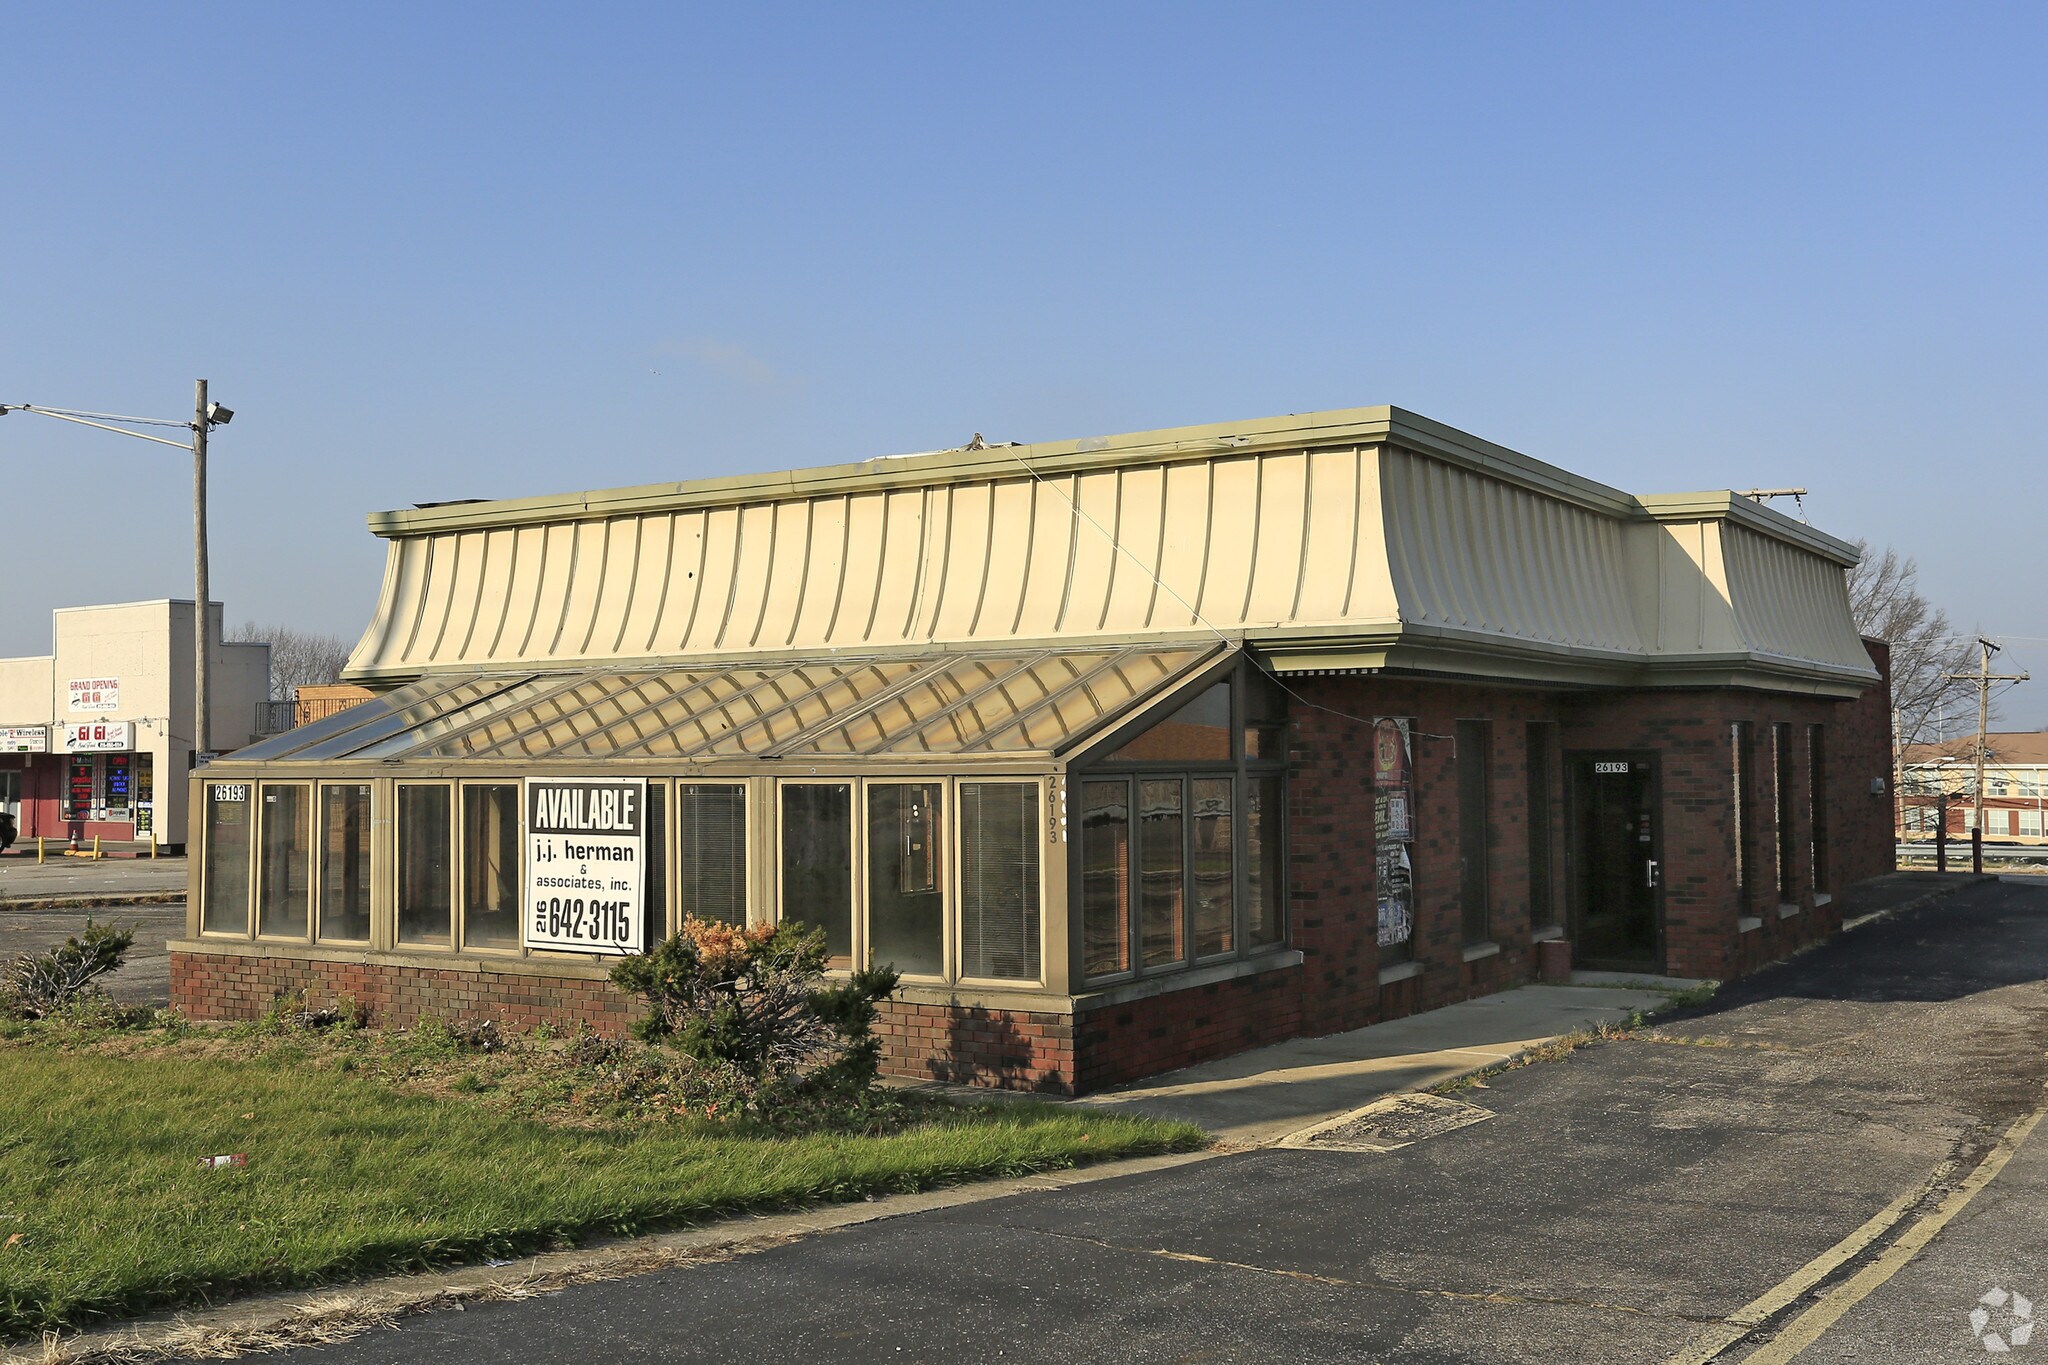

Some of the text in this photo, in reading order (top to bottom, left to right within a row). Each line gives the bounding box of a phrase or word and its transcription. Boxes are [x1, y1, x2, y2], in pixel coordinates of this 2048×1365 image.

[70, 679, 118, 691] GRAND OPENING
[16, 728, 45, 736] Wireless
[1597, 763, 1627, 771] 26193
[216, 785, 244, 800] 26193
[536, 788, 635, 831] AVAILABLE
[1048, 776, 1057, 844] 26193
[537, 839, 634, 862] j.j. herman
[580, 864, 587, 875] &
[536, 875, 632, 892] associates, inc.
[536, 897, 630, 942] 216 642-3115
